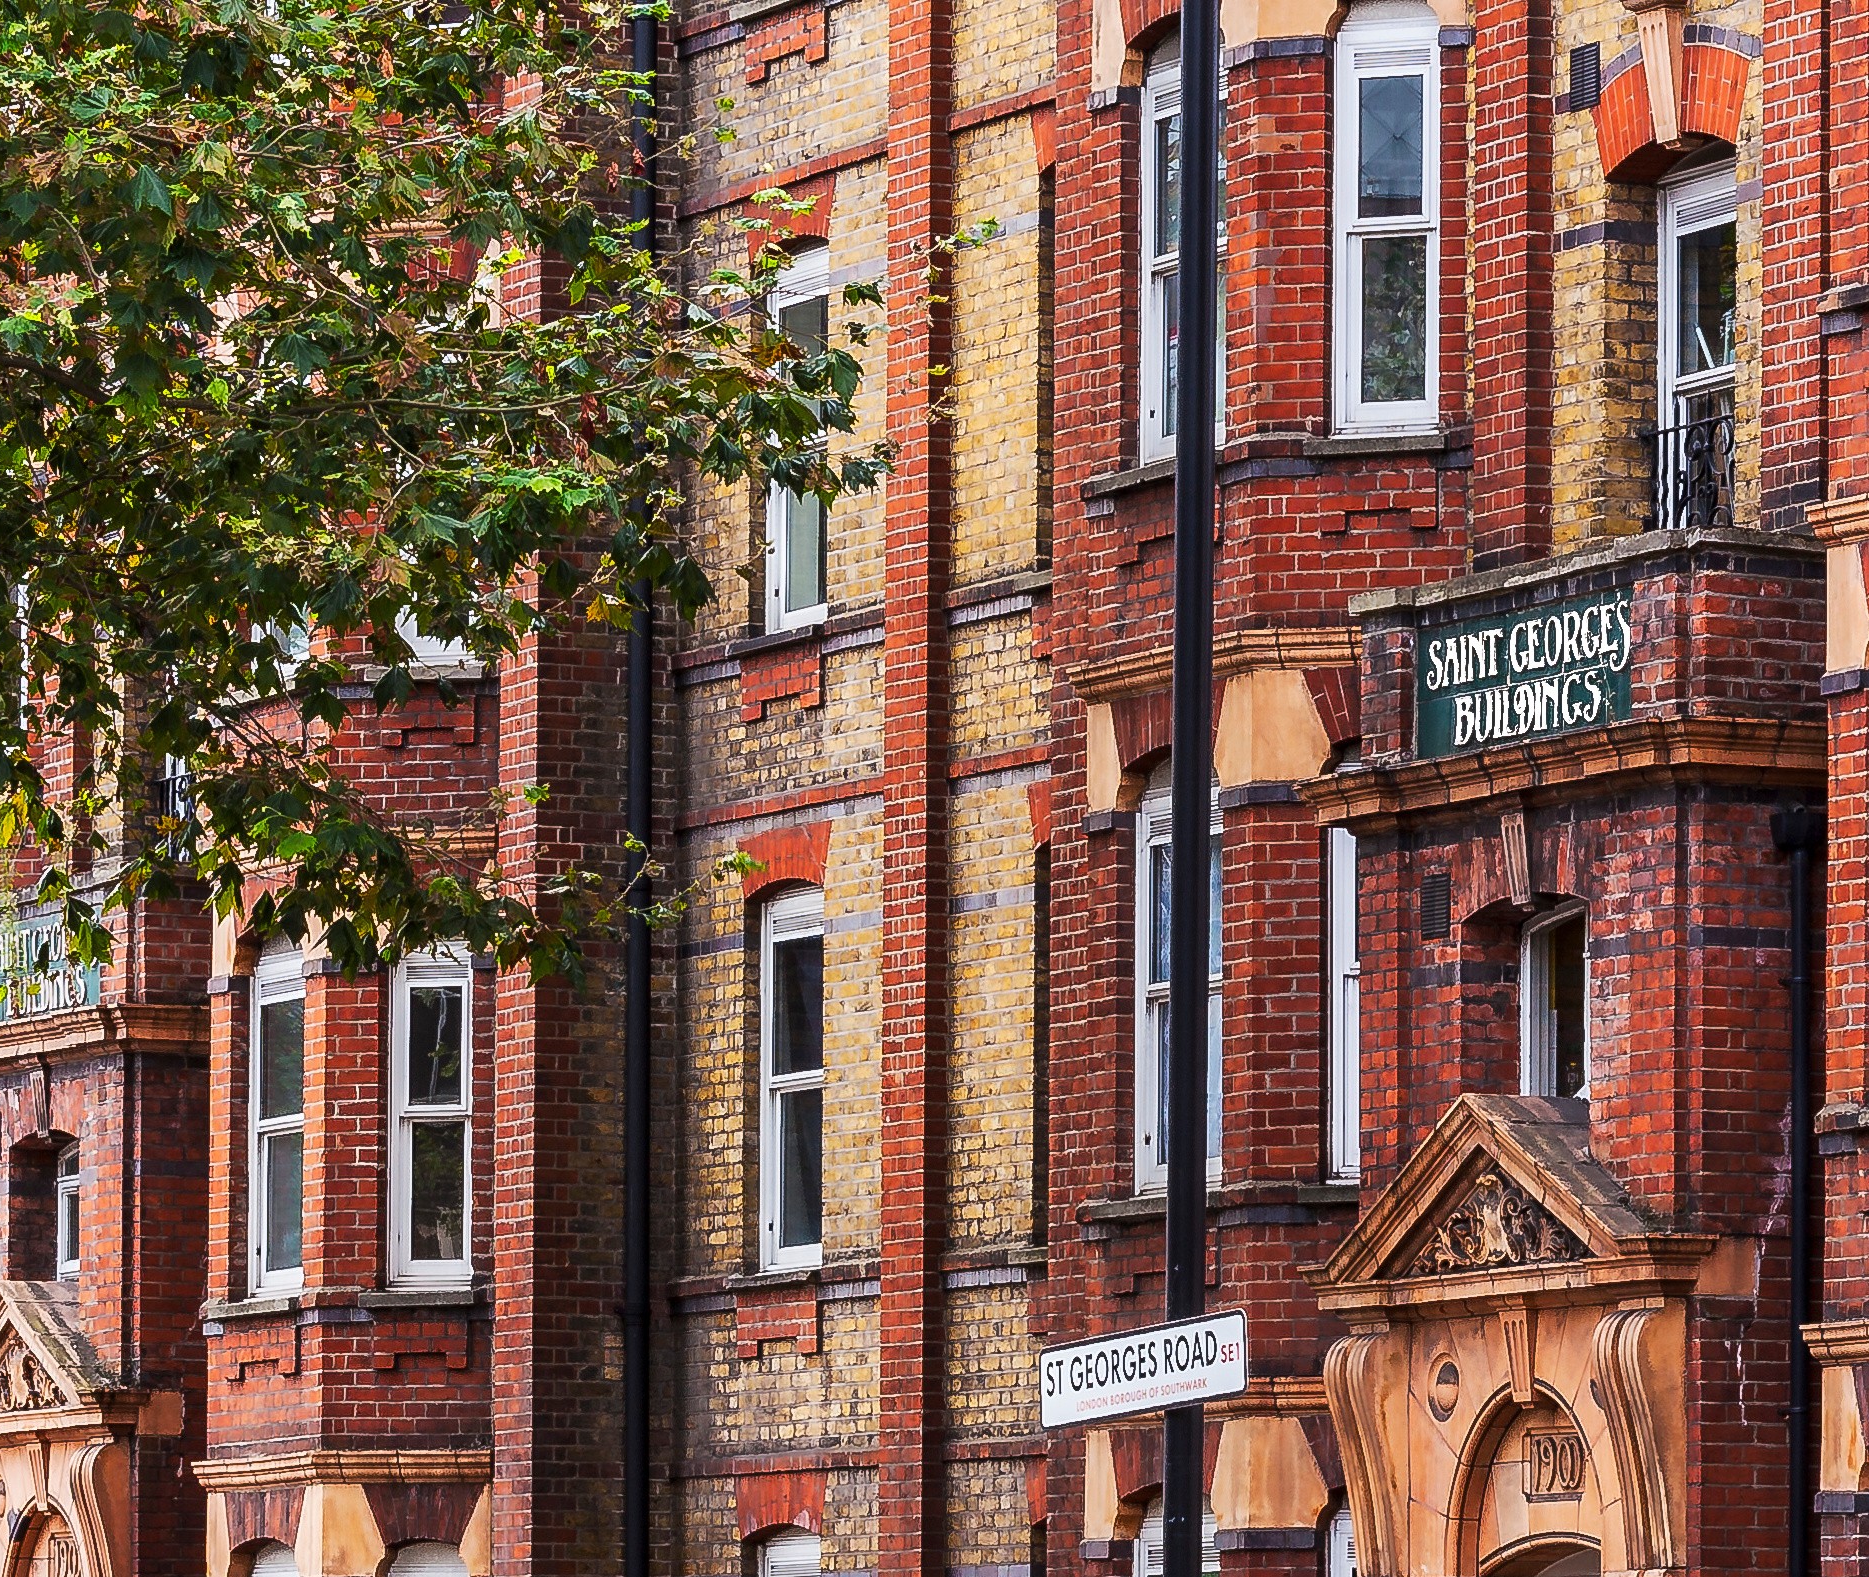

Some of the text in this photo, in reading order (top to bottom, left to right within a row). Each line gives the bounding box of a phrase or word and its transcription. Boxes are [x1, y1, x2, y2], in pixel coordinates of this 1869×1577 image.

[1426, 627, 1503, 690] SAINT
[1454, 671, 1601, 746] BUILDINGS
[1046, 1331, 1240, 1397] ST GEORGES ROAD SE1
[1076, 1378, 1208, 1412] LONDON BOROUGH OF SOUTHWARK
